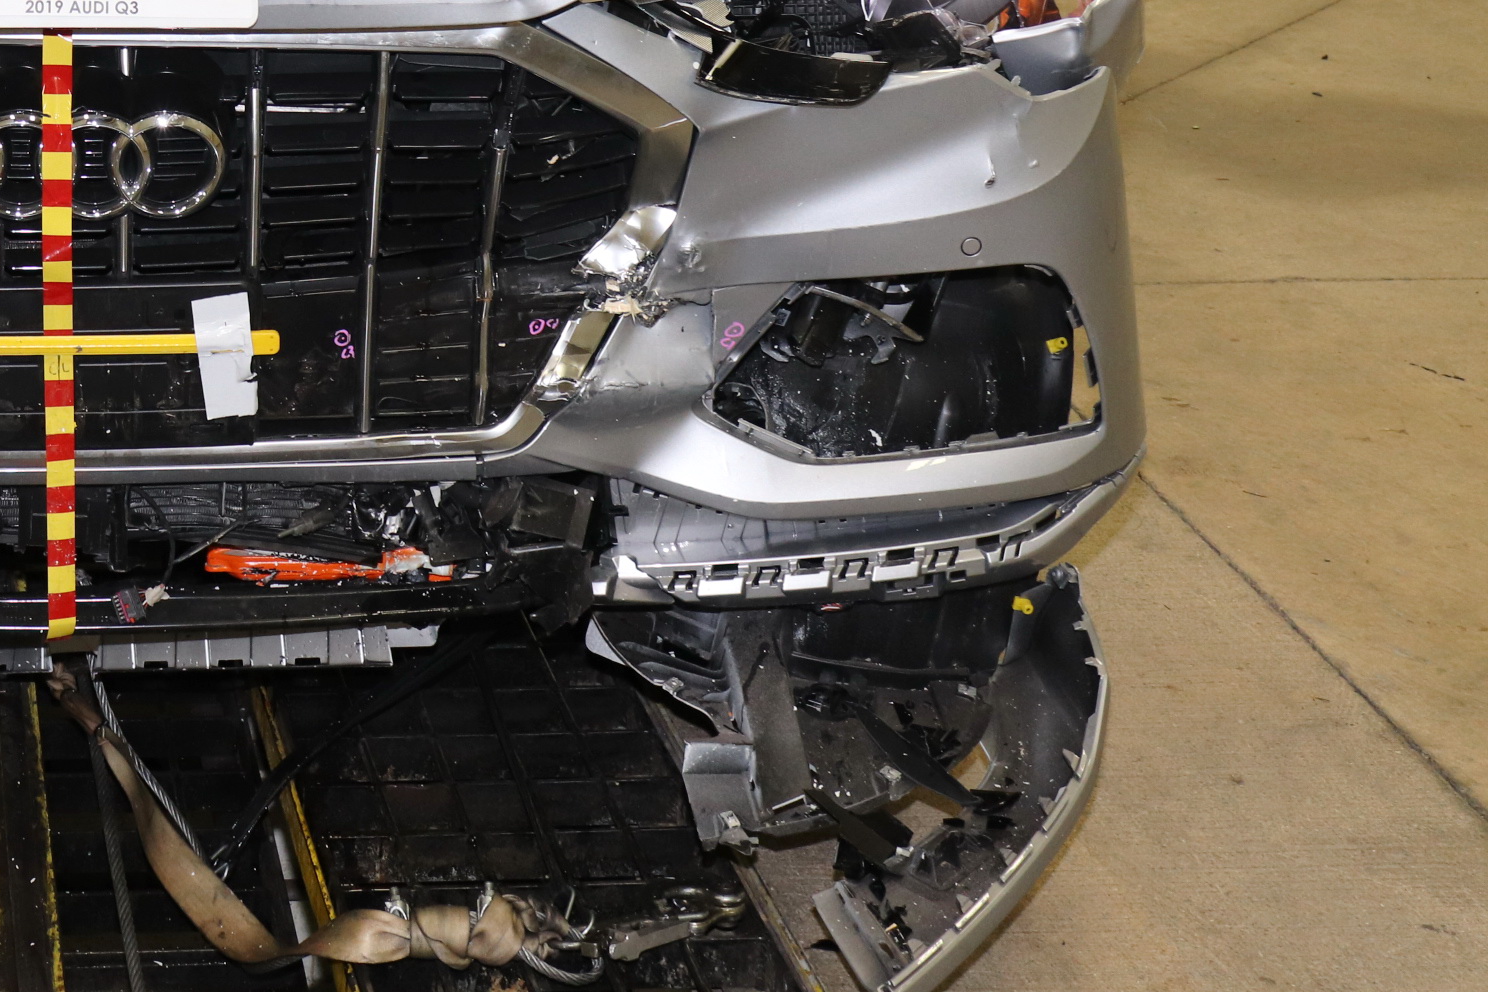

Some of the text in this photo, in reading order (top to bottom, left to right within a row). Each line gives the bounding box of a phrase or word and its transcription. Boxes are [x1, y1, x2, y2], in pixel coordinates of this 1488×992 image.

[25, 0, 139, 15] 2019 AUDI Q3
